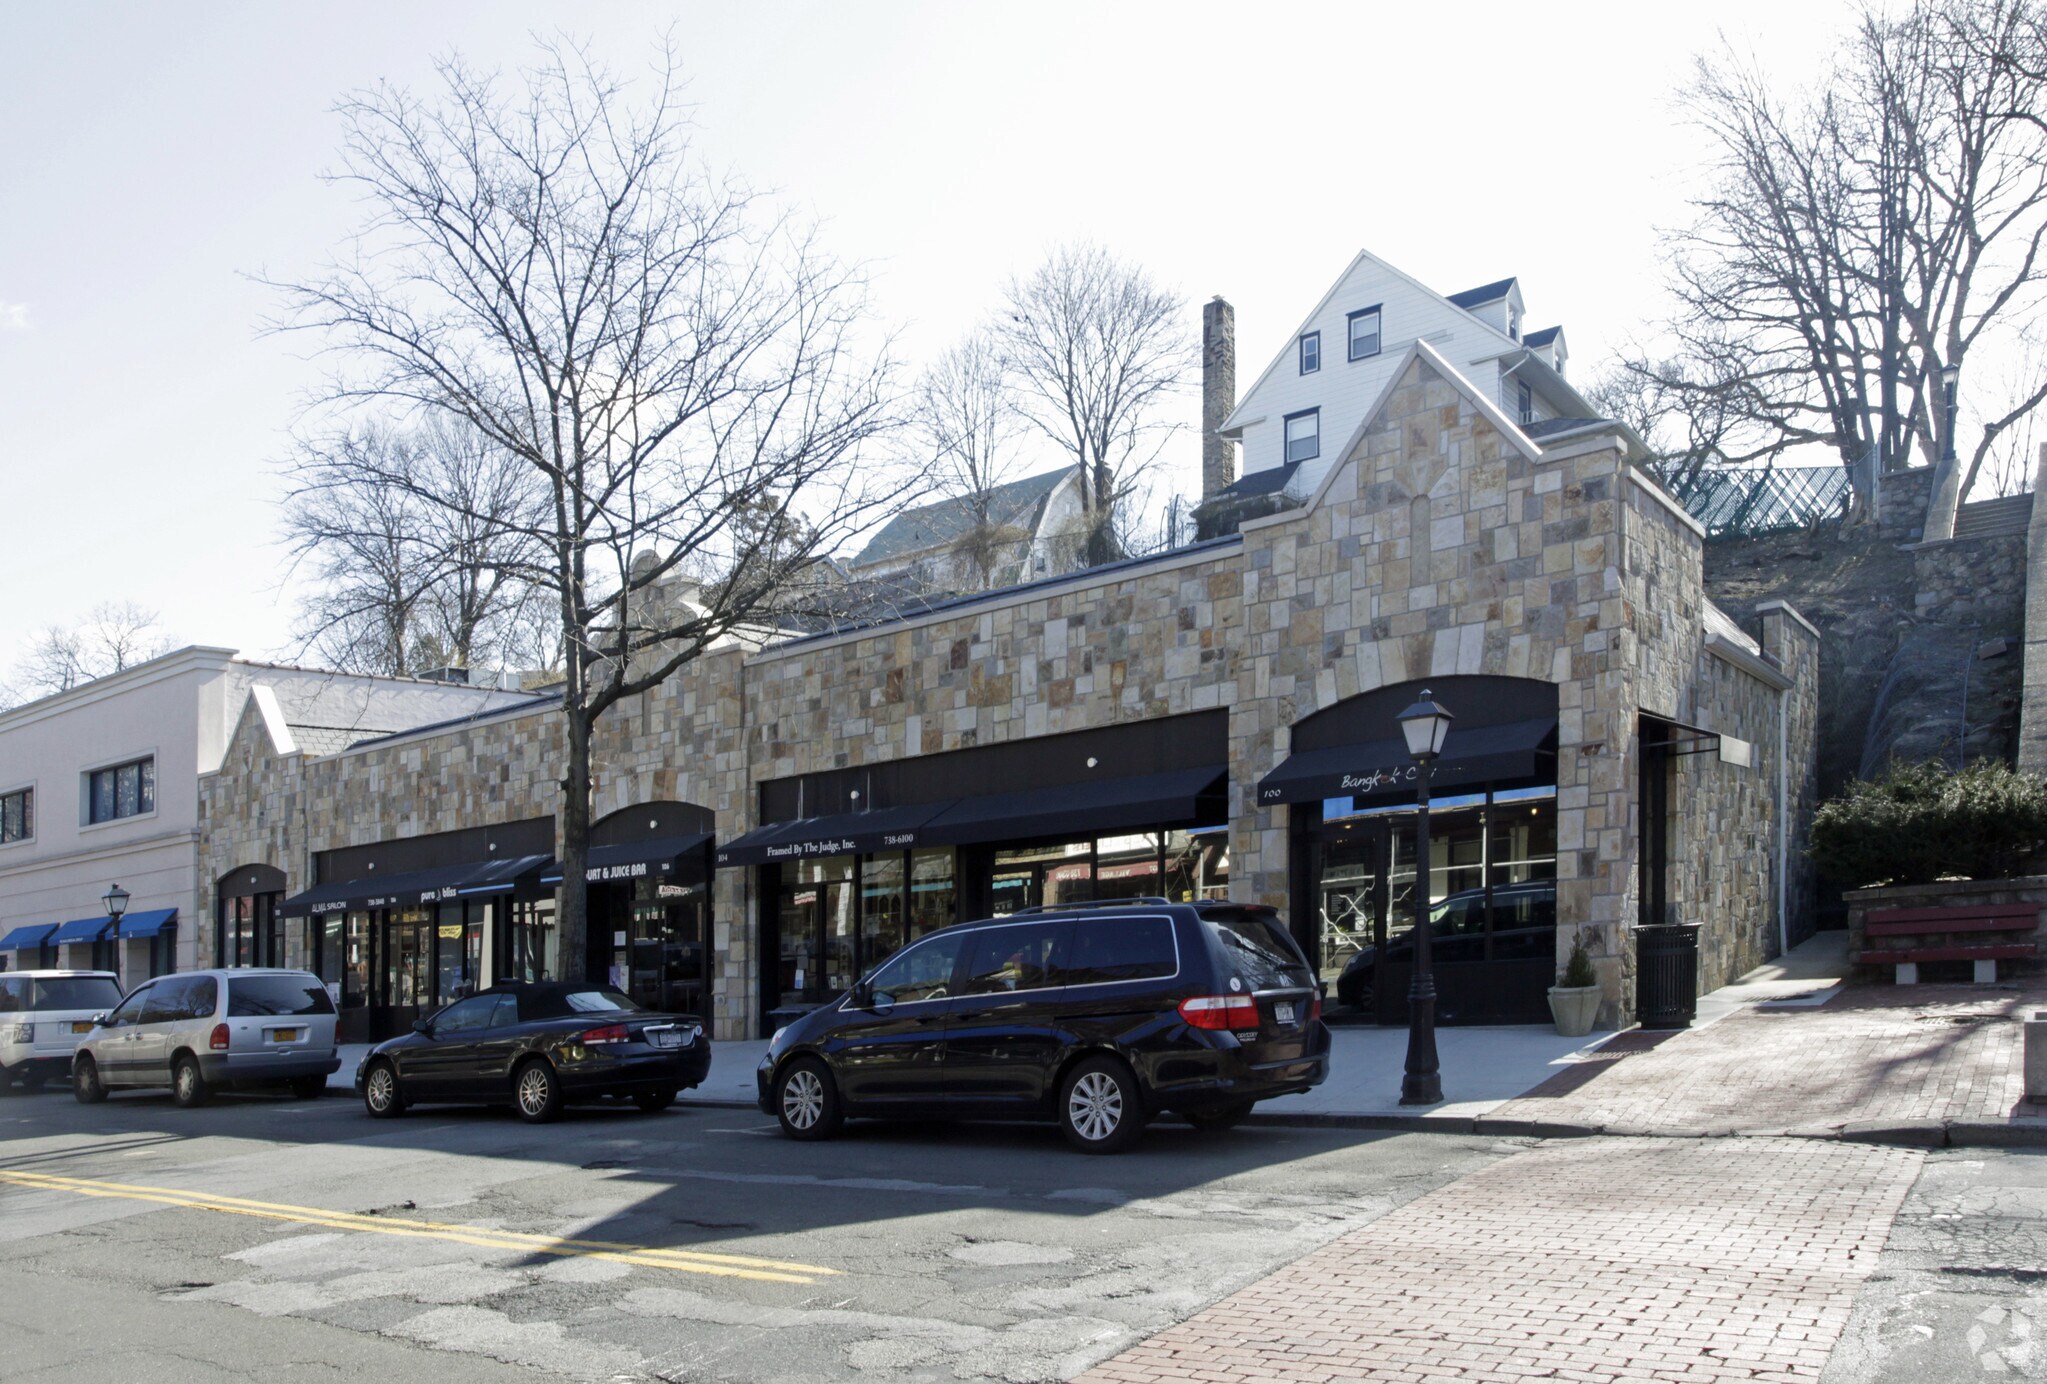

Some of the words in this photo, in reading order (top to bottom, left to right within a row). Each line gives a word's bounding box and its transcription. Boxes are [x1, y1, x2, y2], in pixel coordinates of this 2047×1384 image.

[1341, 765, 1401, 793] Bangkok
[1263, 788, 1282, 799] 100
[883, 833, 914, 846] 738-6100
[767, 843, 793, 857] Framed
[793, 844, 803, 858] By
[803, 841, 819, 854] The
[818, 840, 842, 854] Judge,
[842, 838, 857, 851] Inc.
[717, 853, 728, 863] 104
[586, 867, 602, 881] URT
[602, 866, 610, 880] &
[610, 864, 630, 879] JUICE
[631, 862, 647, 877] BAR
[420, 891, 436, 904] pure
[441, 886, 457, 899] bliss
[326, 900, 347, 911] SALON
